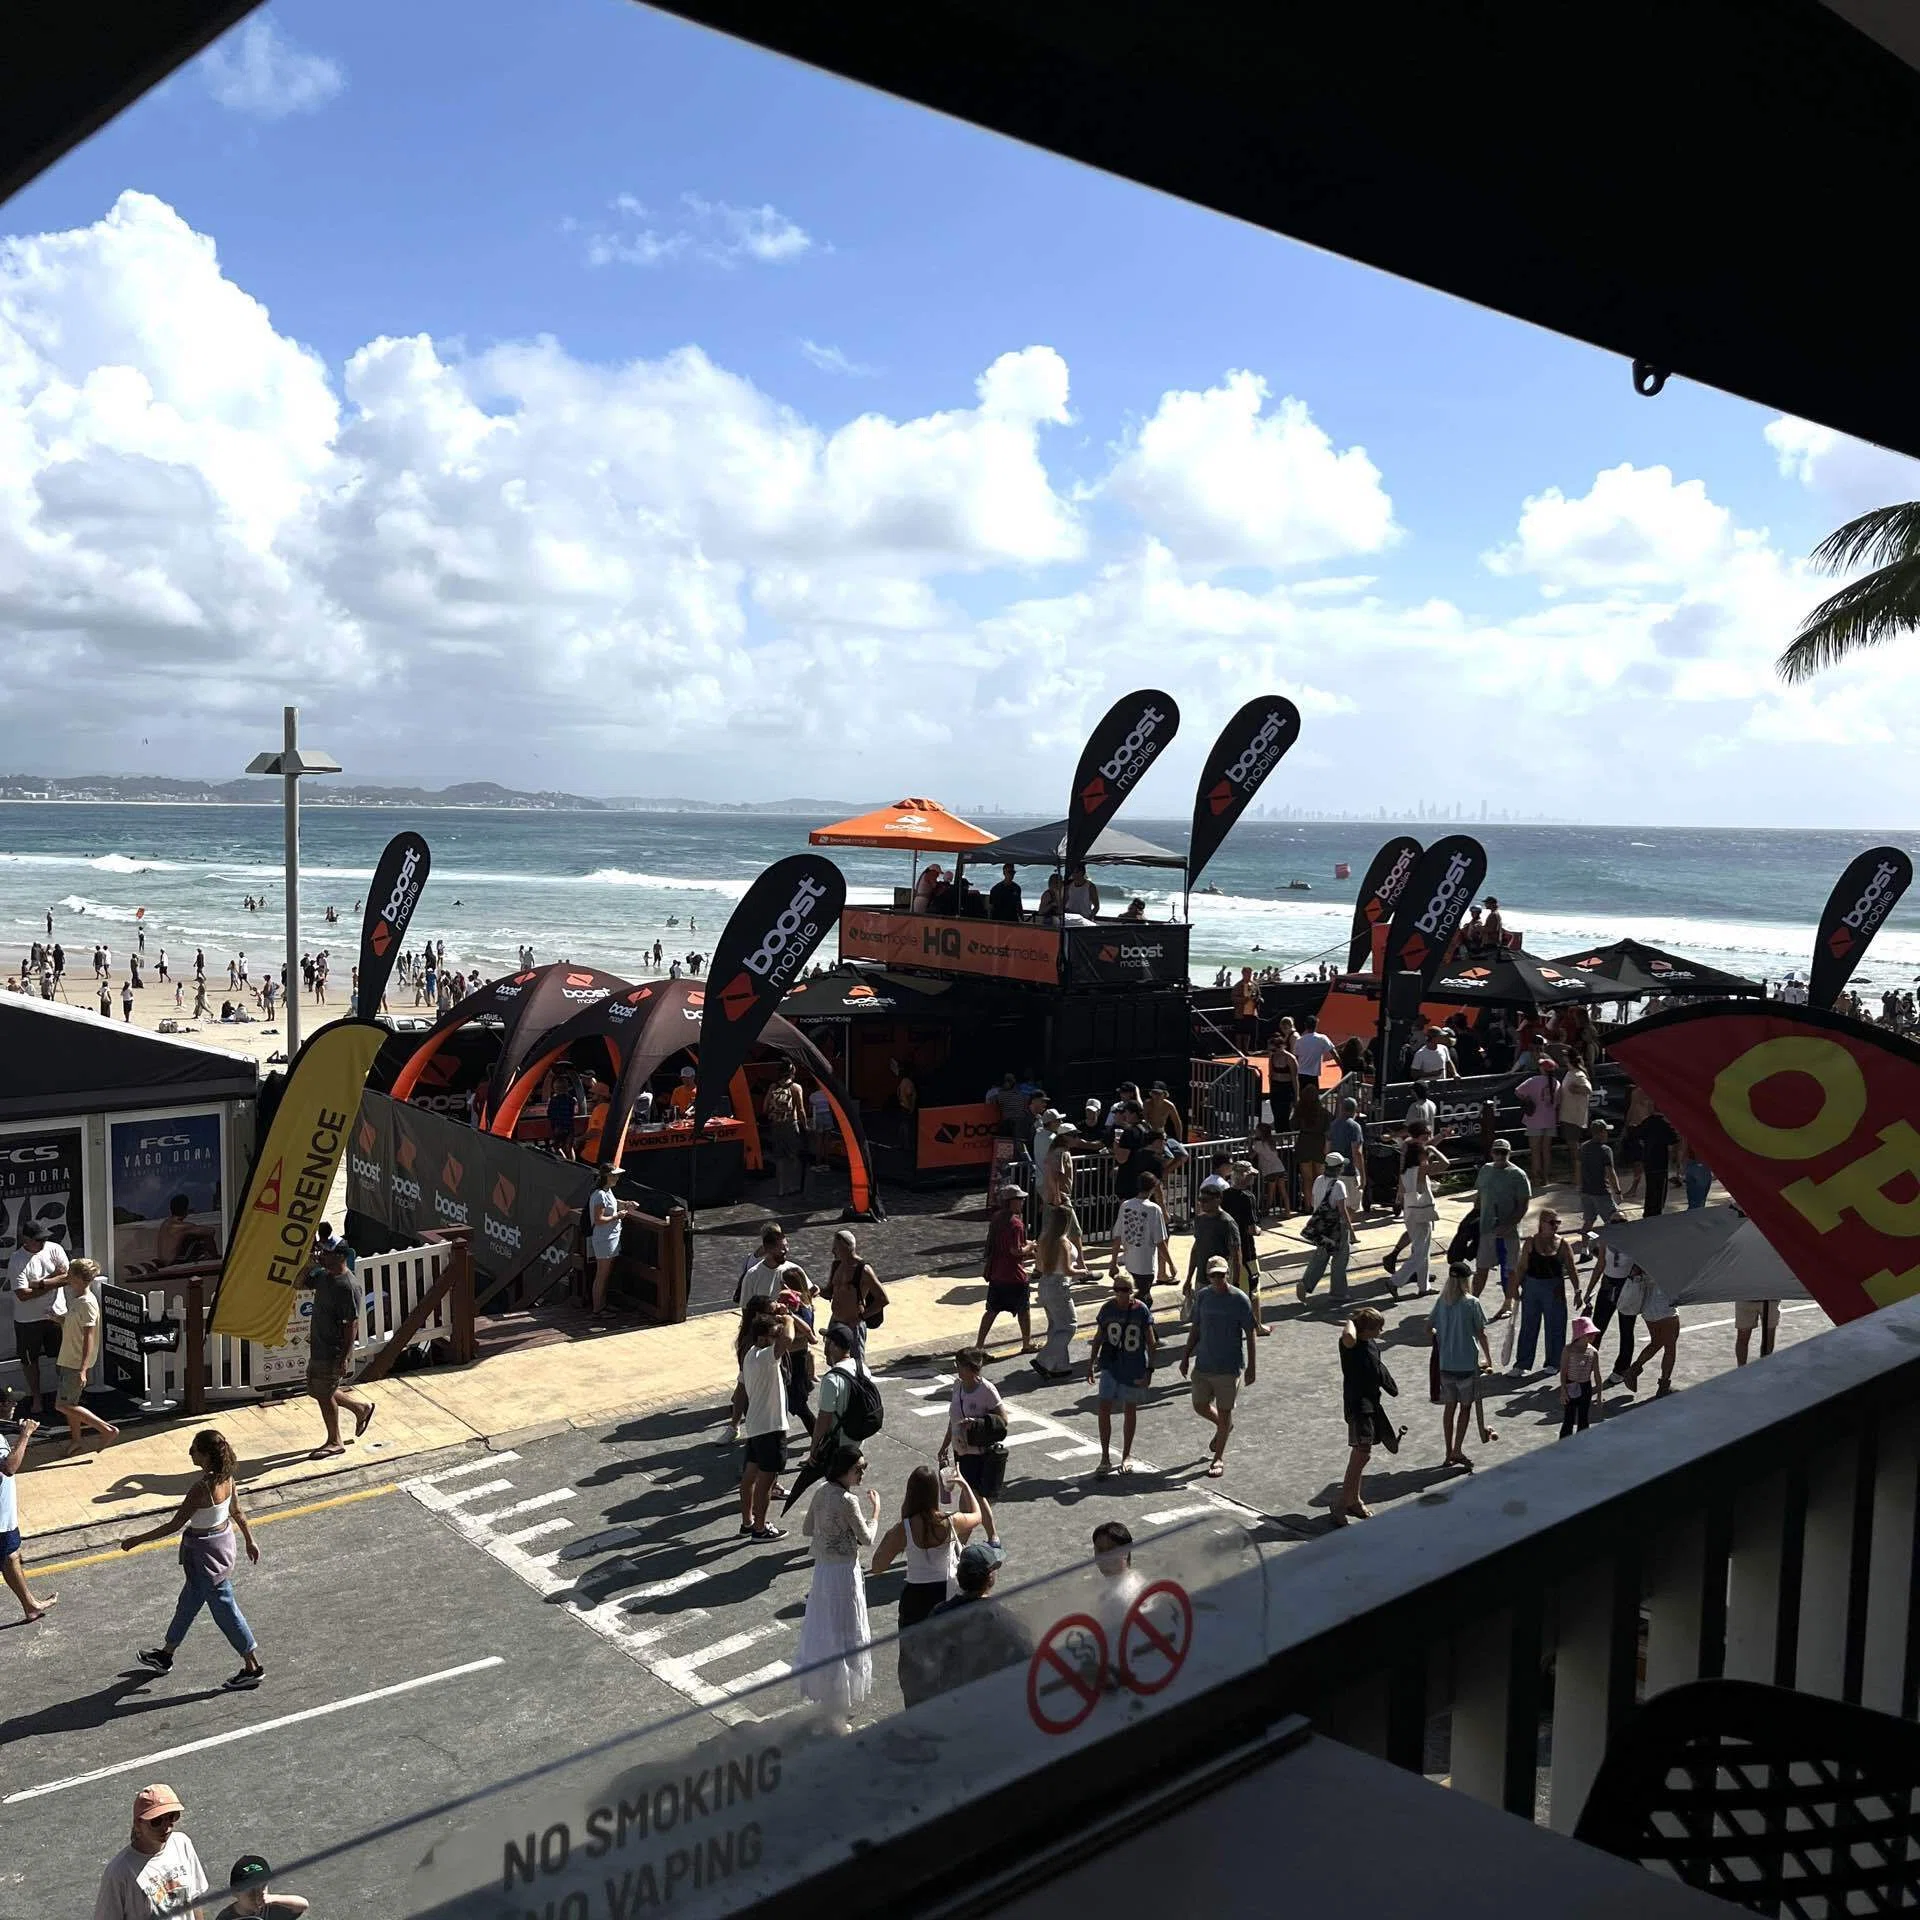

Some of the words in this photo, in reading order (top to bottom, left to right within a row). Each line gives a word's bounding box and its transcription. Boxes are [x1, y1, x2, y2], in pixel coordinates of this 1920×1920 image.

[1100, 706, 1166, 780] boost
[1116, 741, 1157, 790] mobile
[1225, 711, 1288, 784] boost
[1242, 744, 1280, 792] mobile
[381, 847, 421, 922] boost
[1374, 847, 1416, 900] boost
[1414, 852, 1472, 934] boost
[1841, 861, 1899, 928] boost
[395, 881, 419, 931] mobile
[742, 876, 828, 976] boost
[1434, 887, 1469, 942] mobile
[1860, 891, 1894, 936] mobile
[768, 922, 819, 988] mobile
[923, 926, 961, 960] HQ
[1120, 944, 1164, 959] boost
[1120, 959, 1150, 968] mobile
[496, 983, 523, 997] boost
[561, 987, 611, 998] boost
[1439, 977, 1489, 987] boost
[608, 1001, 638, 1018] boost
[1439, 1095, 1500, 1123] boot
[124, 1152, 162, 1169] YAGO
[173, 1147, 212, 1163] DORA
[140, 1134, 191, 1149] FCS
[629, 1135, 669, 1147] WORKS
[671, 1132, 687, 1144] ITS
[28, 1167, 70, 1184] DORA
[352, 1153, 381, 1183] boost
[1710, 1035, 1920, 1309] OP
[267, 1107, 347, 1286] FLORENCE
[434, 1189, 469, 1224] boost
[484, 1212, 521, 1249] boost
[503, 1822, 570, 1893] NO
[585, 1746, 782, 1859] SMOKING
[605, 1821, 763, 1920] VAPING
